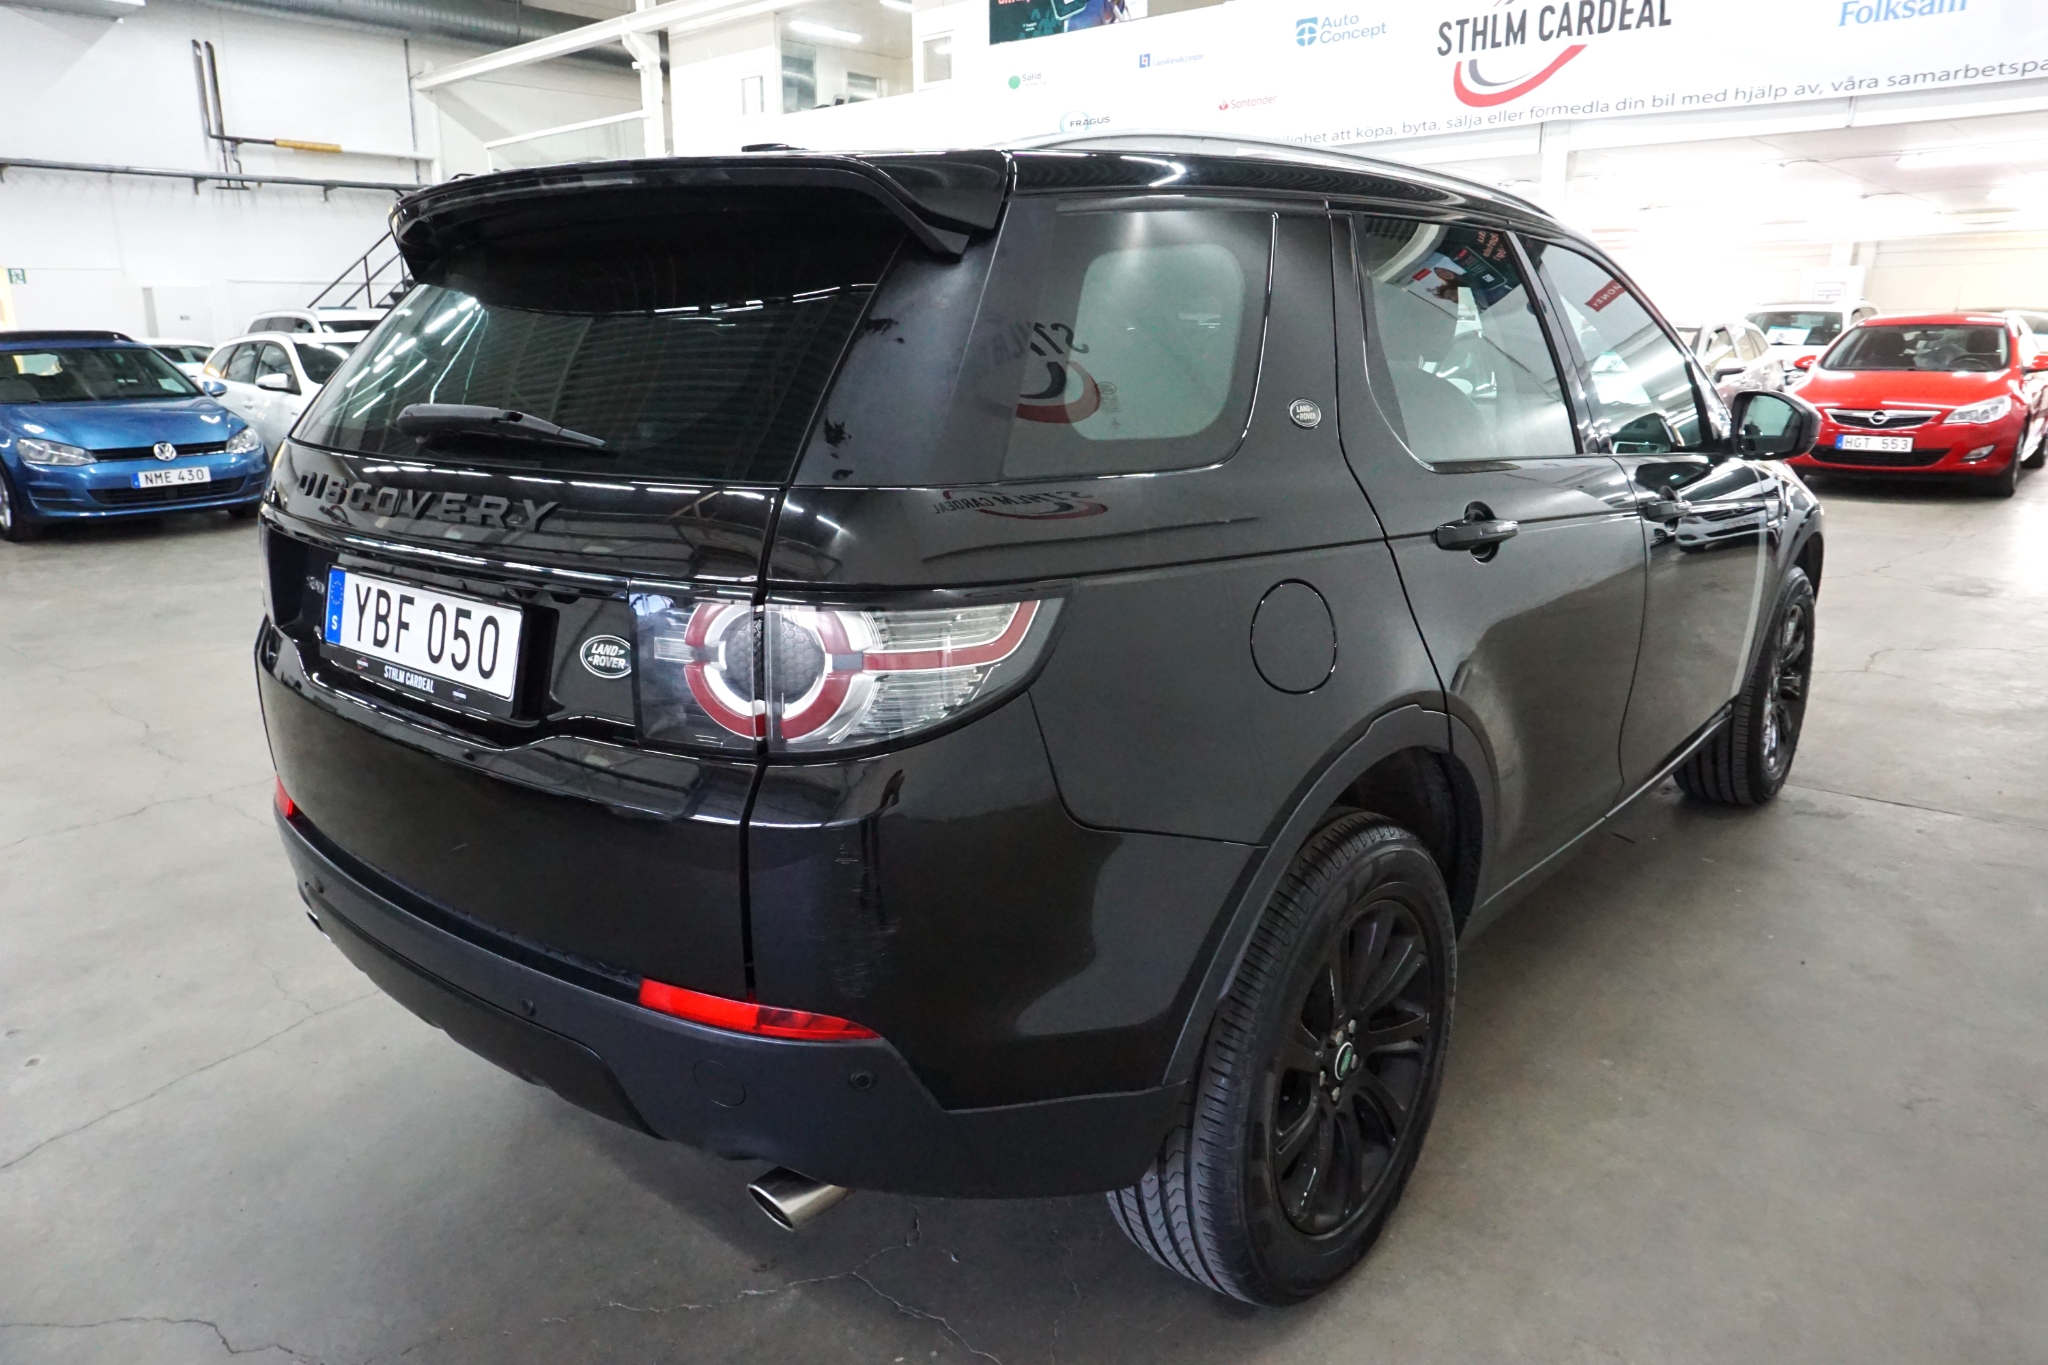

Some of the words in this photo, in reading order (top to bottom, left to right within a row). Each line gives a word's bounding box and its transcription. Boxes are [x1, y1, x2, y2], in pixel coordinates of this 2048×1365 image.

[1838, 0, 1967, 27] Folksam
[1321, 14, 1360, 30] Auto
[1437, 9, 1527, 57] STHLM
[1538, 0, 1672, 41] CARDEAL
[1320, 21, 1387, 44] Concept
[1022, 72, 1042, 82] Solid
[1230, 95, 1277, 110] Santander
[1331, 129, 1351, 142] att
[1356, 124, 1397, 139] köpa,
[1402, 120, 1440, 135] byta,
[1446, 114, 1482, 130] sälja
[1487, 110, 1525, 124] eller
[1529, 100, 1610, 119] förmedla
[1615, 97, 1645, 111] din
[1651, 92, 1676, 108] bil
[1682, 89, 1727, 105] med
[1734, 84, 1788, 104] hjälp
[1794, 83, 1824, 96] av,
[1831, 75, 1879, 92] våra
[1069, 116, 1111, 128] FRAGUS
[1295, 405, 1311, 414] LAND
[1299, 412, 1316, 421] ROVER
[1844, 437, 1871, 448] HGT
[1881, 438, 1909, 450] 553
[144, 471, 173, 485] NME
[177, 468, 205, 482] 430
[296, 470, 561, 533] DISCOVERY
[331, 615, 339, 631] S
[355, 583, 416, 653] YBF
[427, 602, 500, 680] 050
[590, 643, 620, 657] LAND
[592, 654, 626, 670] ROVER
[383, 665, 405, 684] STHLM
[405, 672, 435, 694] CARDEAL
